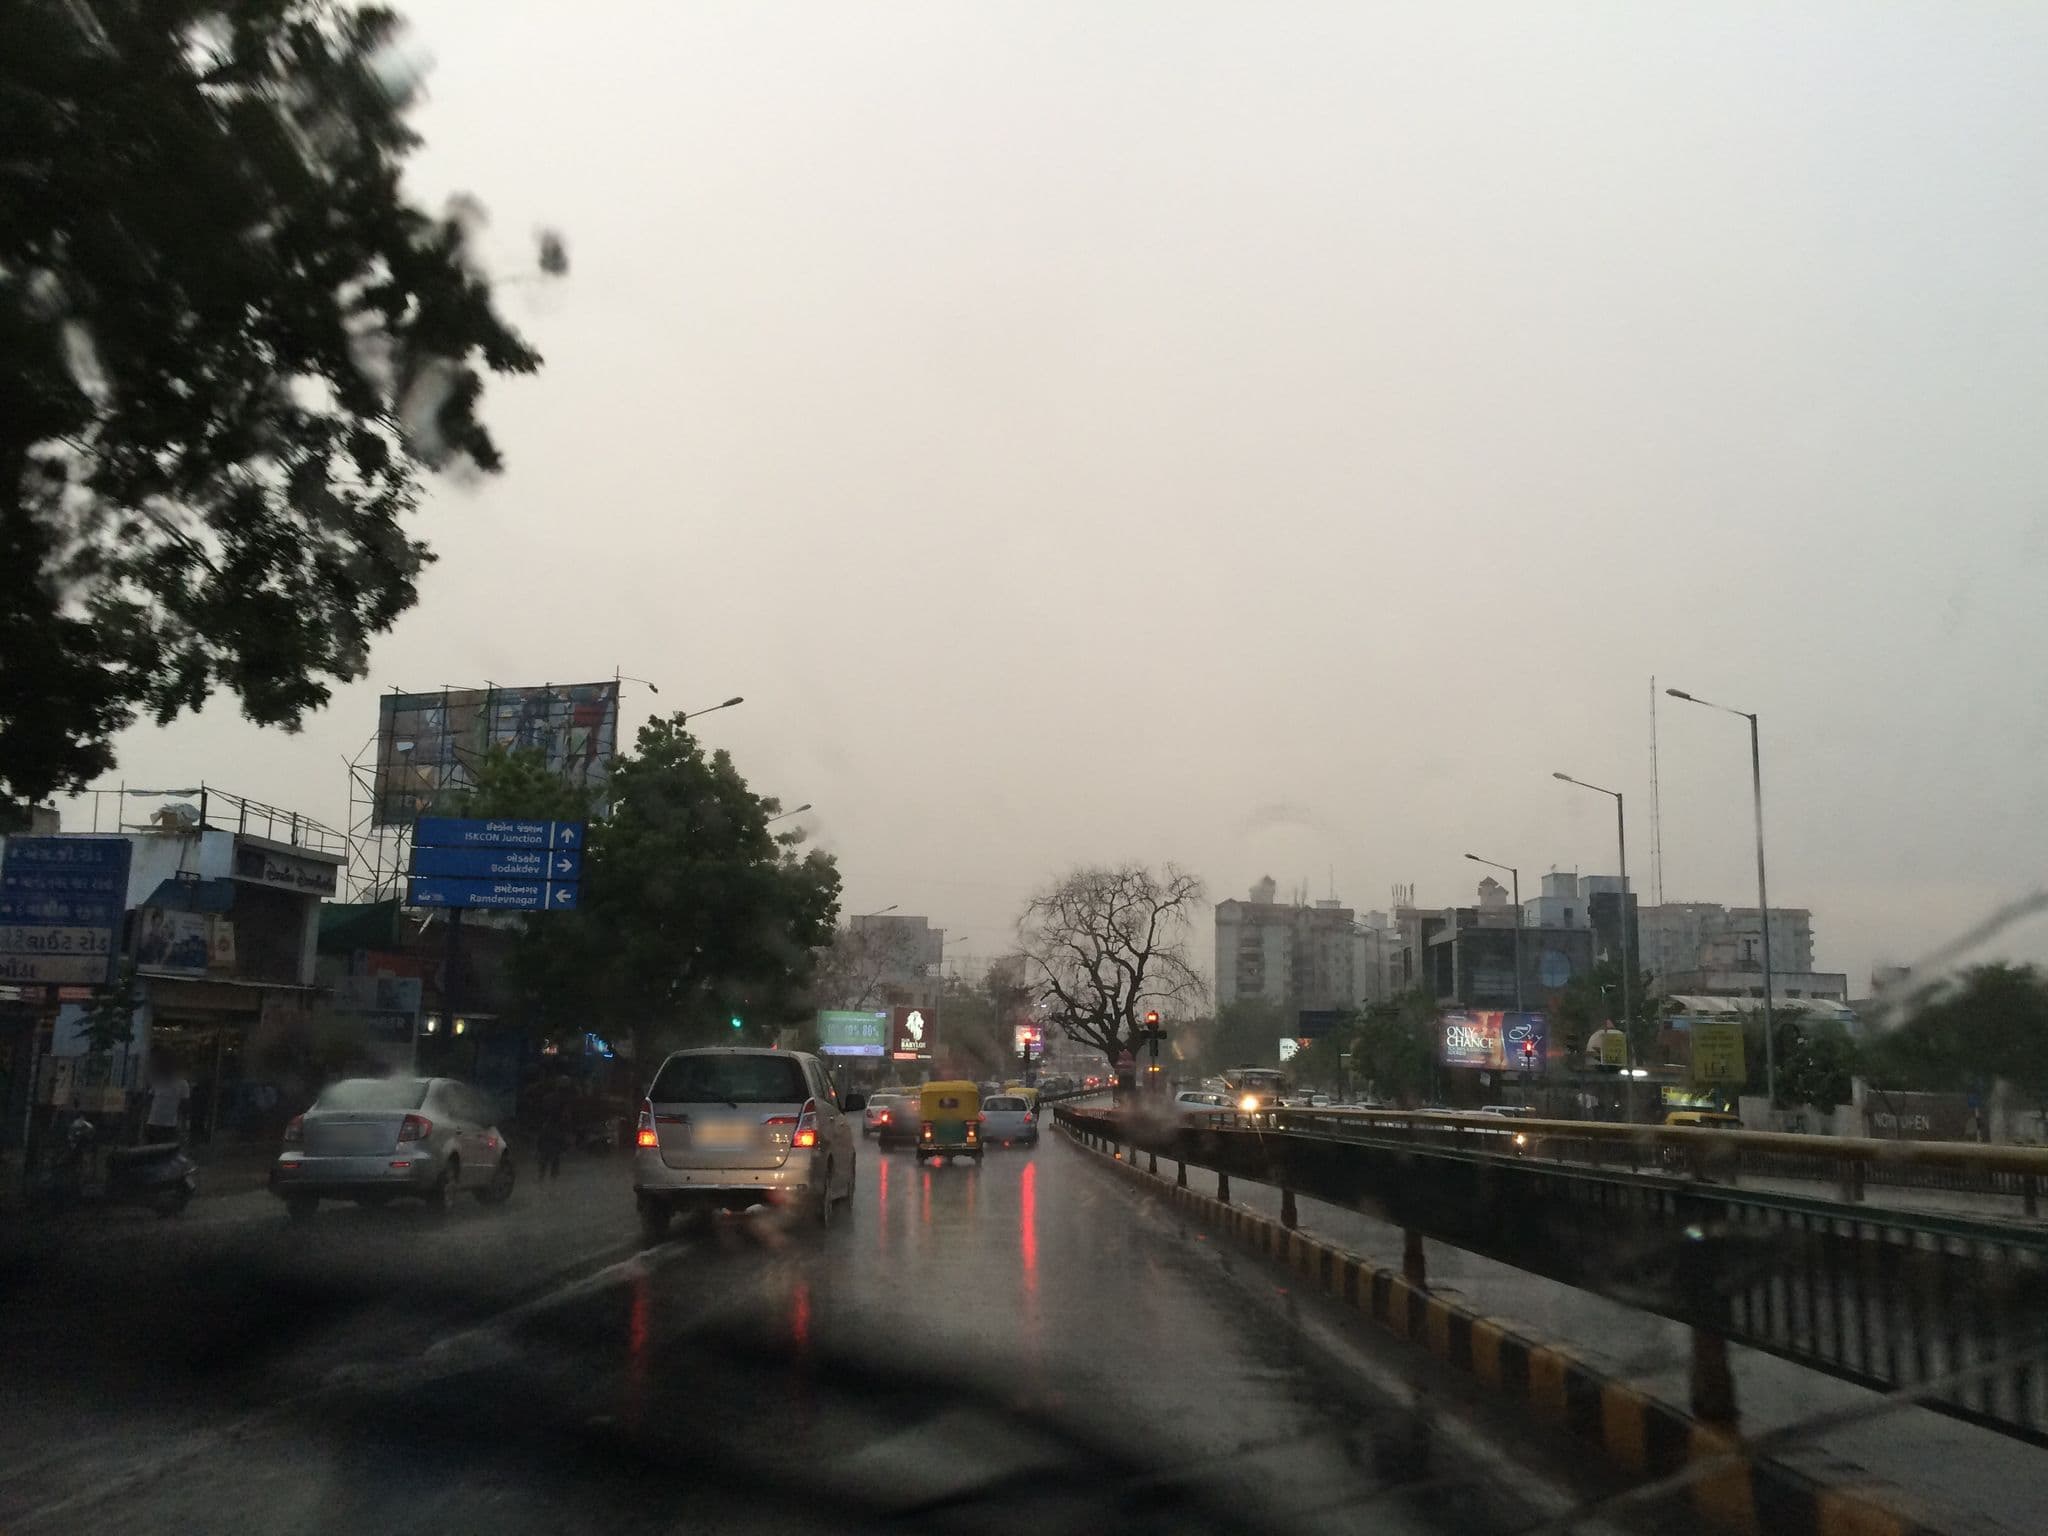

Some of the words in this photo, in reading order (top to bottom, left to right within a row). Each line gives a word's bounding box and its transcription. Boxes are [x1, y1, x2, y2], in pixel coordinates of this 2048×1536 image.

[465, 832, 499, 842] ISKCON
[502, 833, 542, 844] Junction
[490, 863, 540, 874] Bodakdev
[469, 893, 537, 906] Ramdevnagar
[1446, 1025, 1476, 1038] ONLY
[1446, 1036, 1495, 1049] CHANCE
